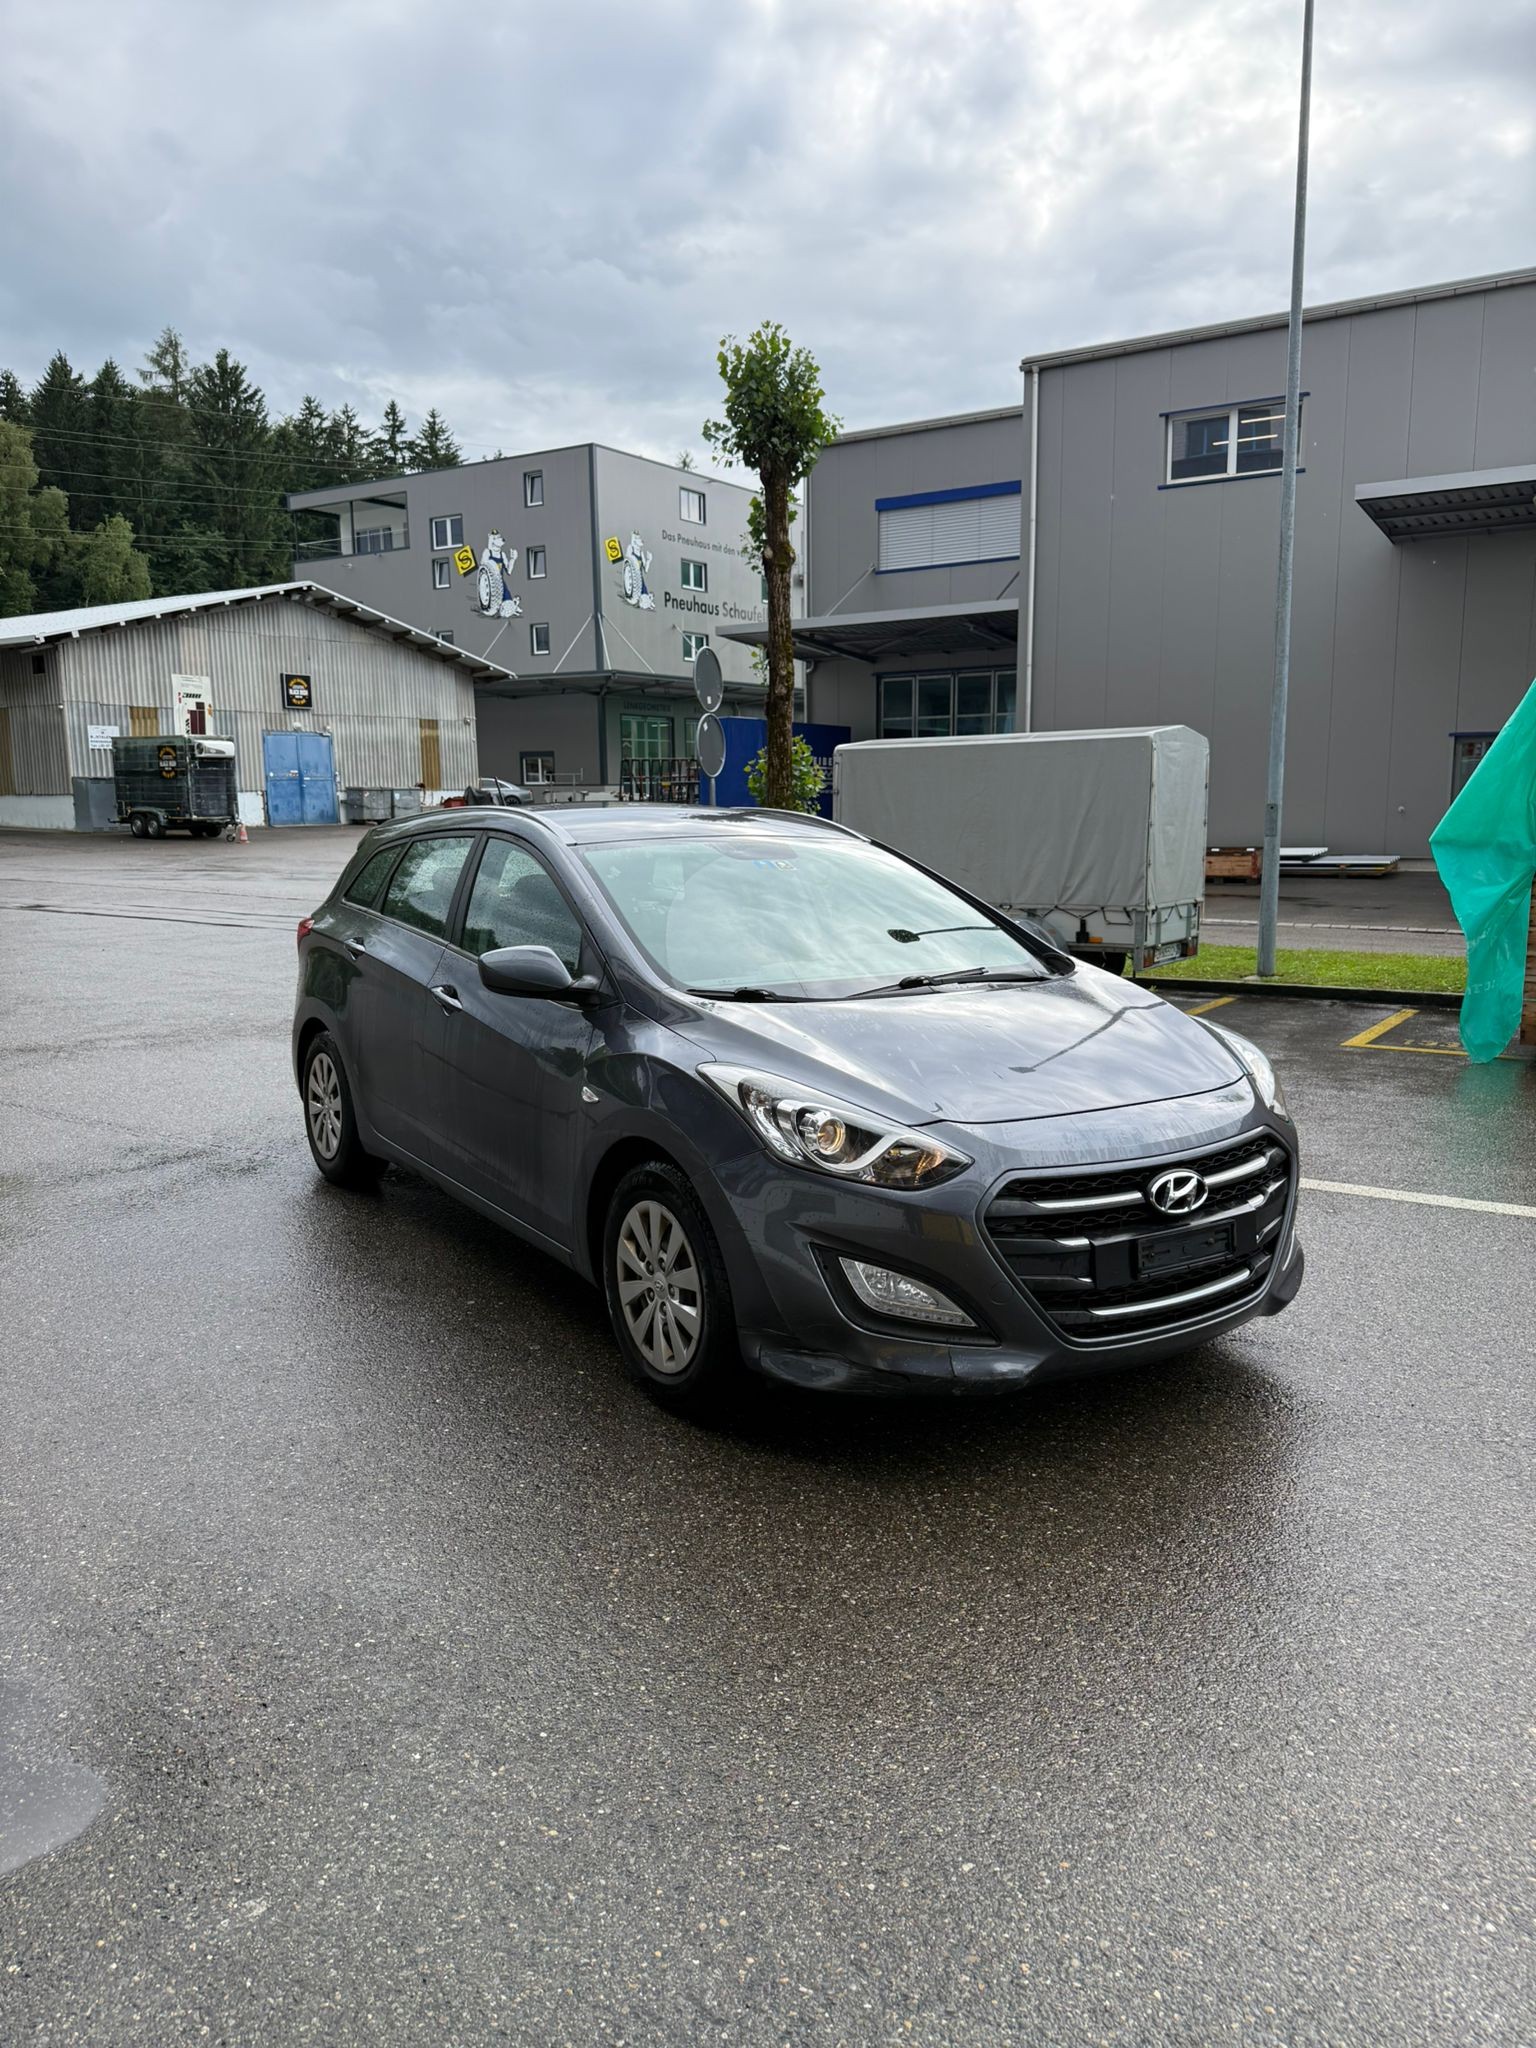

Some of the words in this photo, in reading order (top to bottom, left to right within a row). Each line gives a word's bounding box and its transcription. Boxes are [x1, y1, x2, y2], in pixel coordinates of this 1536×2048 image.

[662, 529, 676, 543] Das
[677, 533, 711, 550] Pneuhaus
[712, 543, 722, 553] mit
[723, 544, 736, 556] den
[664, 591, 720, 616] Pneuhaus
[722, 601, 769, 622] Schaufel
